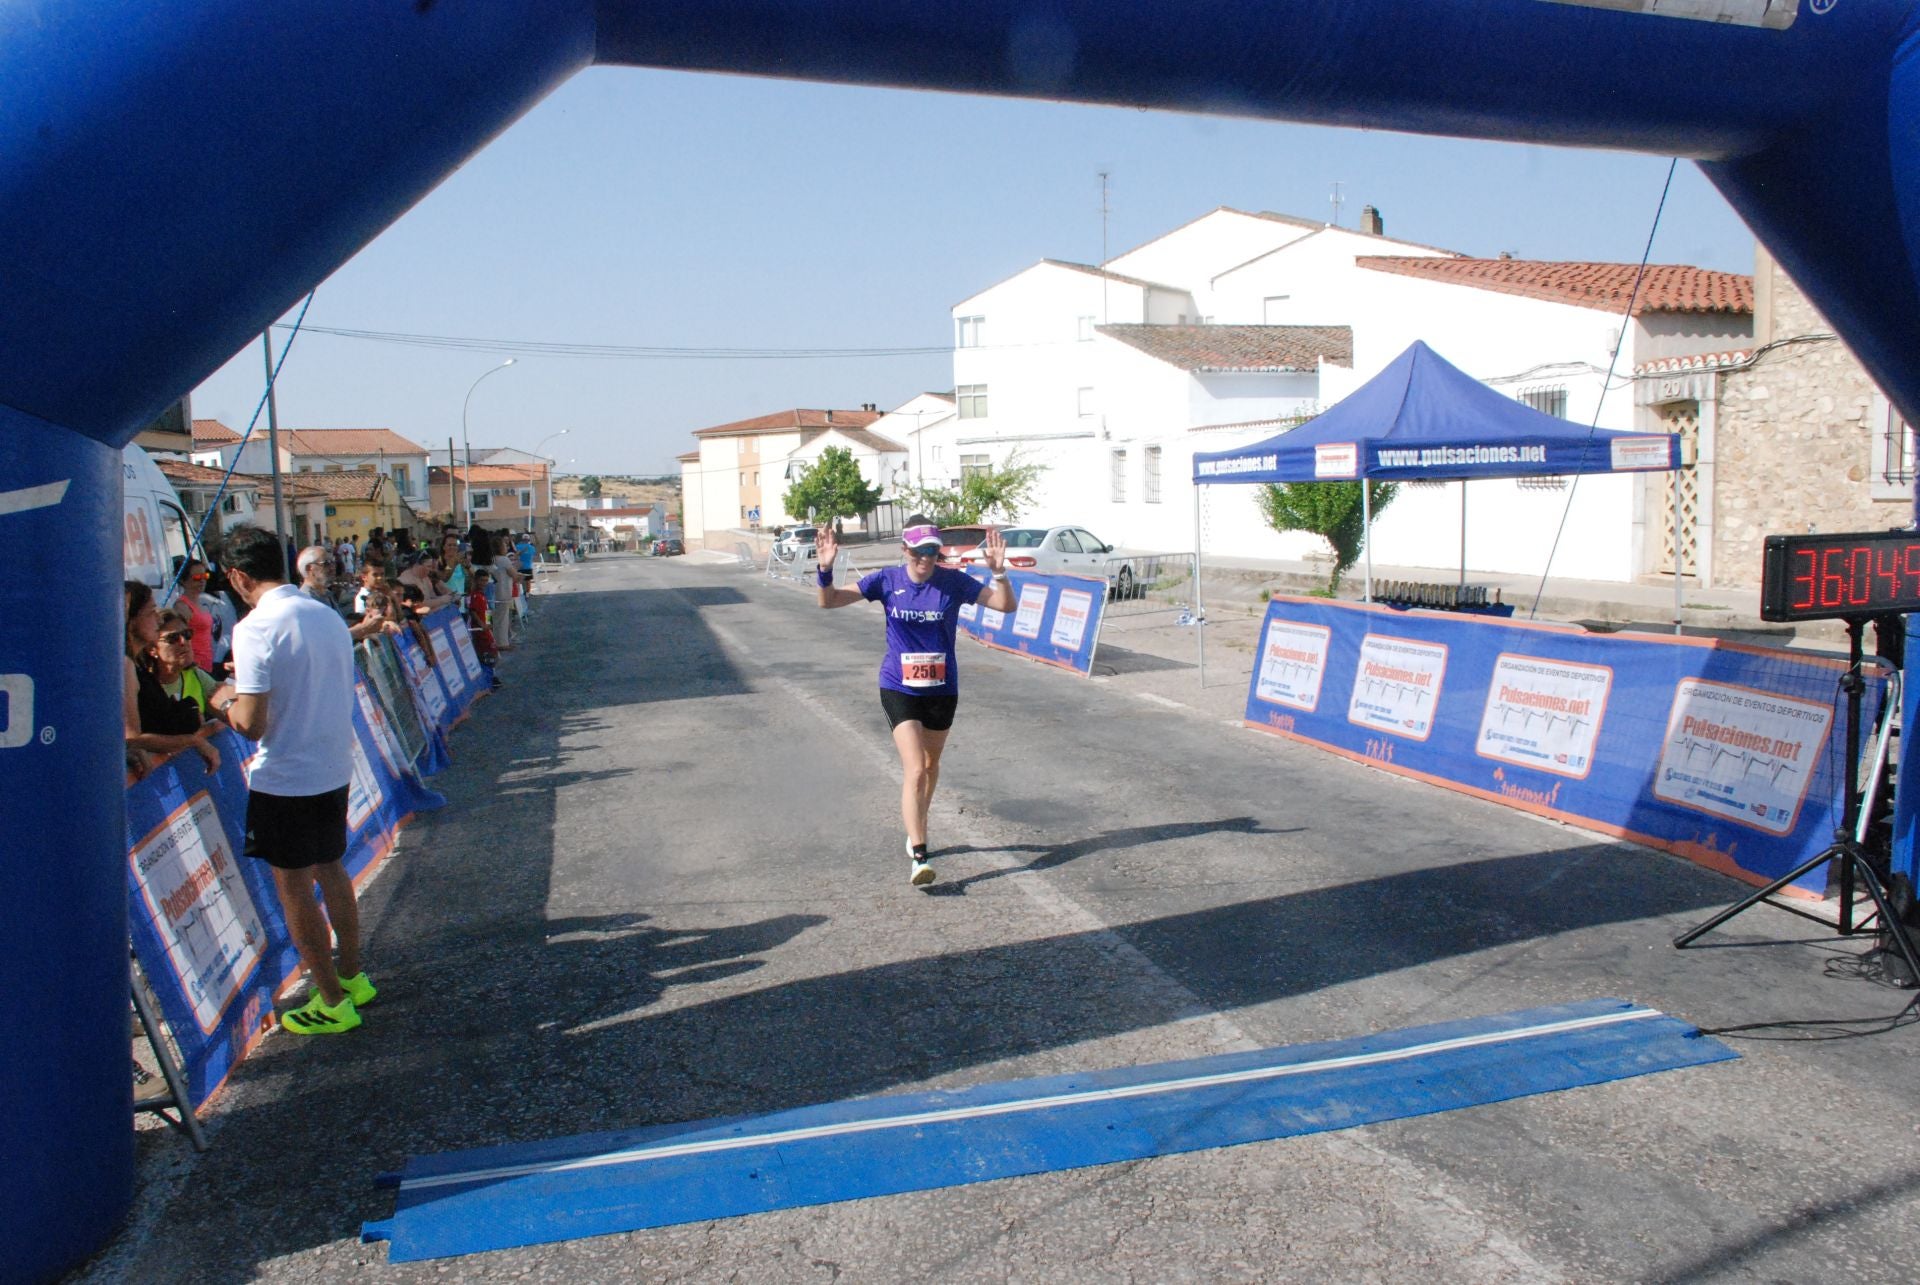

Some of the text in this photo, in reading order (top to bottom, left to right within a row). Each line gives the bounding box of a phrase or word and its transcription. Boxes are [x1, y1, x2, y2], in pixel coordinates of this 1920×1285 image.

[1664, 381, 1681, 398] 20
[1198, 454, 1278, 476] www.pulsaciones.net
[1377, 445, 1546, 467] www.pulsaciones.net
[1364, 661, 1432, 688] Pulsaciones.net
[1545, 668, 1570, 680] EVENTOS
[1499, 685, 1591, 716] Pulsaciones.net
[1733, 696, 1743, 706] DE
[1744, 699, 1776, 713] EVENTOS
[1776, 706, 1825, 724] DEPORTIVOS
[1682, 715, 1803, 762] Pulsaciones.net
